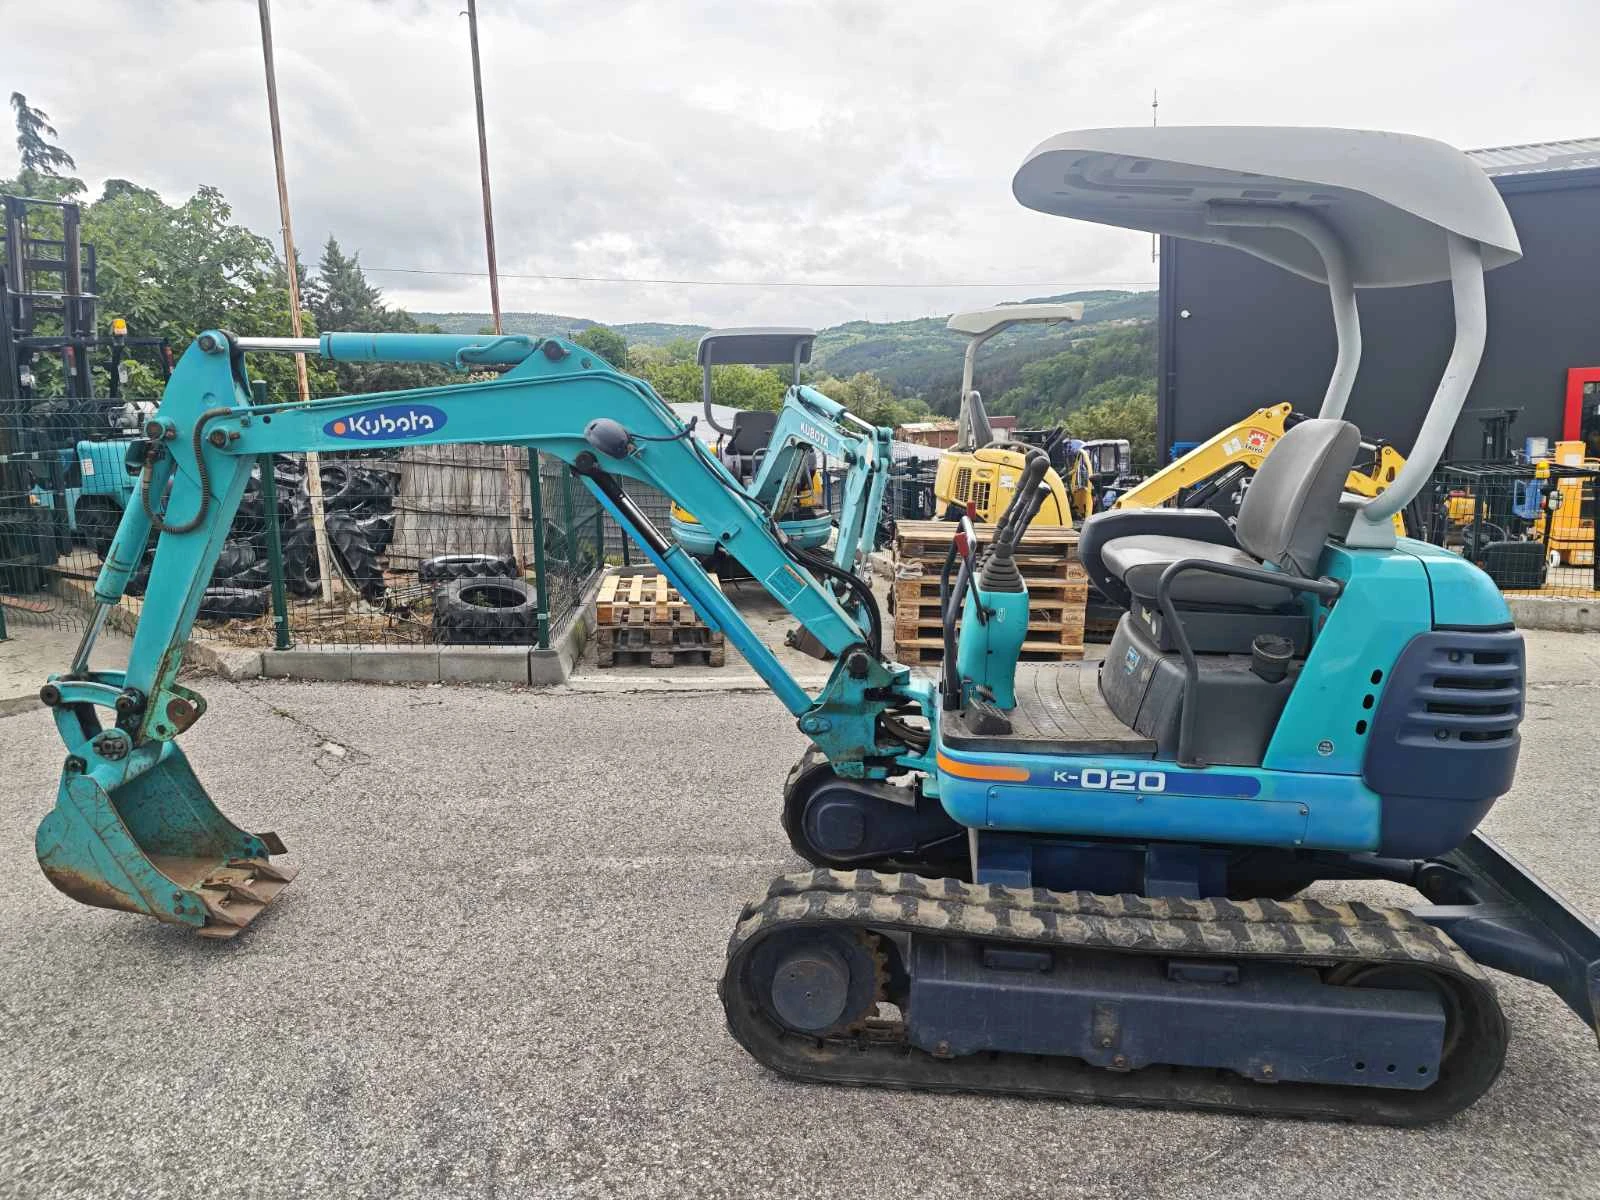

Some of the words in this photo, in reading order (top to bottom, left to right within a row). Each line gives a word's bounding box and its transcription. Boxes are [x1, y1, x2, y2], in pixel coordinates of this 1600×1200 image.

[348, 410, 434, 436] Kubota
[800, 421, 829, 449] KUBOTA
[1053, 768, 1166, 792] K-020
